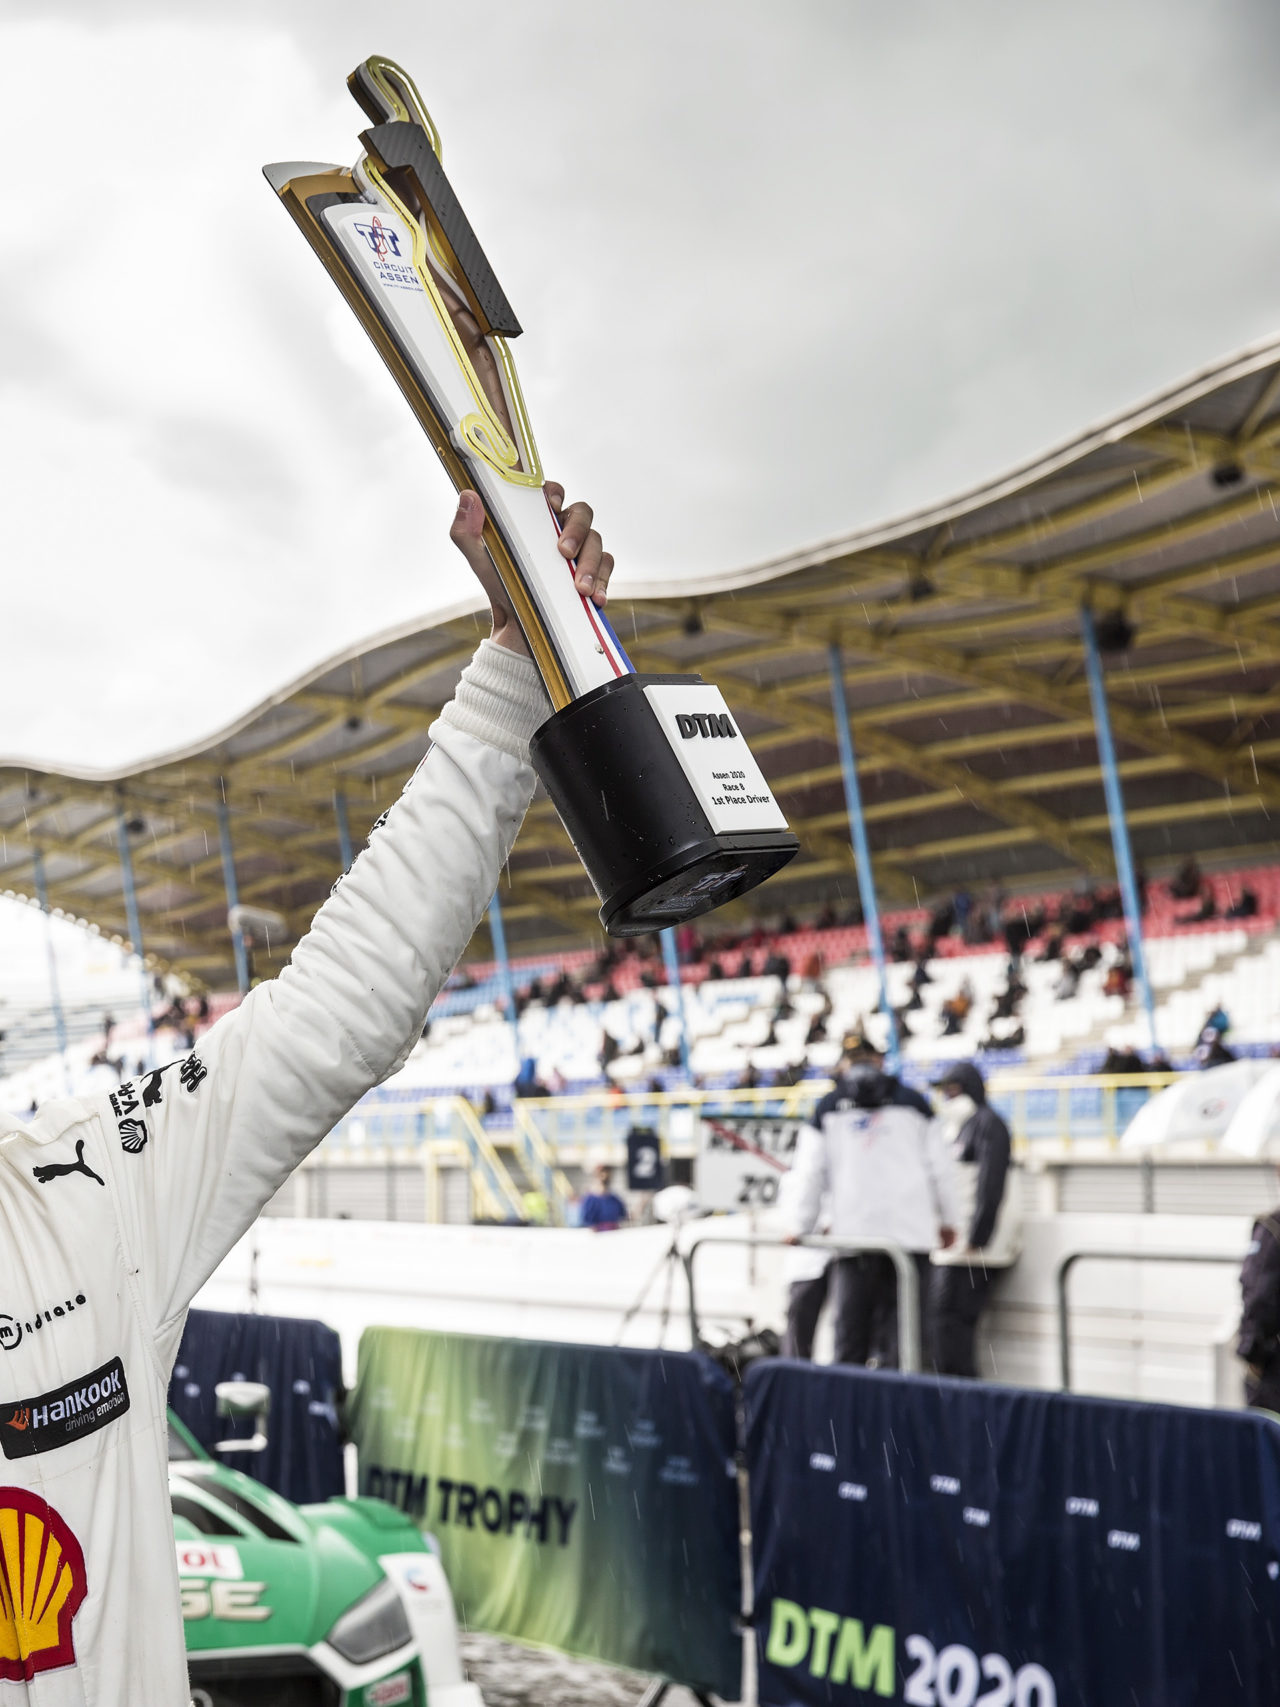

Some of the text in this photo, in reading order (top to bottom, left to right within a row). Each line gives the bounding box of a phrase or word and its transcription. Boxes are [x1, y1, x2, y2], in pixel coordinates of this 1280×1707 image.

[373, 261, 414, 274] CIRCUIT
[380, 271, 419, 285] ASSEN
[675, 713, 737, 739] DTM
[712, 770, 746, 779] Assen 2020
[722, 783, 739, 791] Race
[711, 794, 770, 805] 1st Place Driver
[65, 1409, 96, 1432] driving
[368, 1464, 577, 1546] DTM TROPHY
[765, 1597, 1058, 1707] DTM 2020
